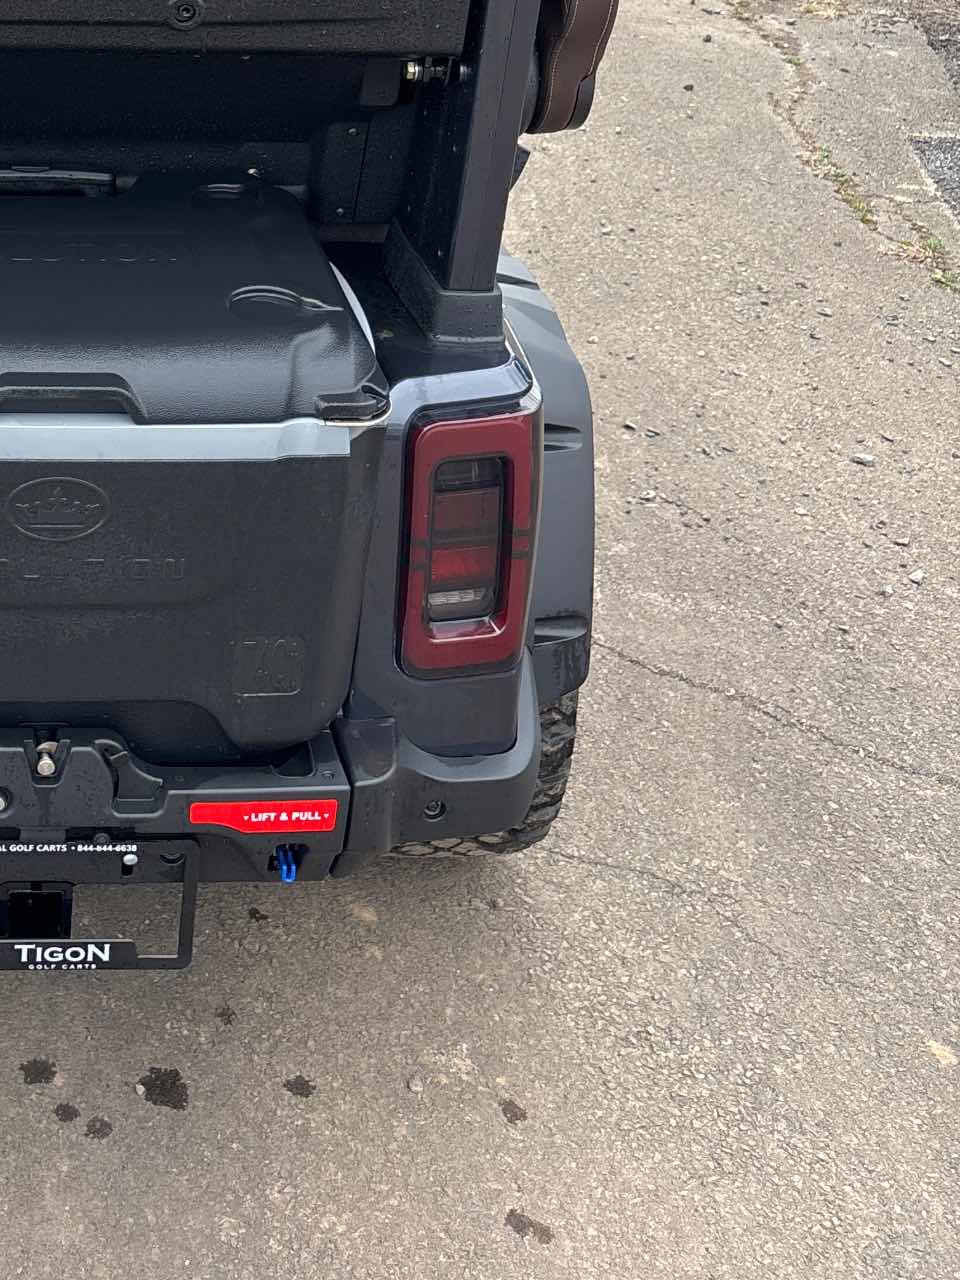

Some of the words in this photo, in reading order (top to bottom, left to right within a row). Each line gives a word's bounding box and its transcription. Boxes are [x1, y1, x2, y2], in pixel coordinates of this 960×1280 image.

[250, 812, 277, 822] LIFT
[279, 812, 289, 821] &
[291, 811, 322, 821] PULL
[9, 844, 35, 852] GOLF
[36, 844, 67, 852] CARTS
[14, 943, 111, 962] TIGON
